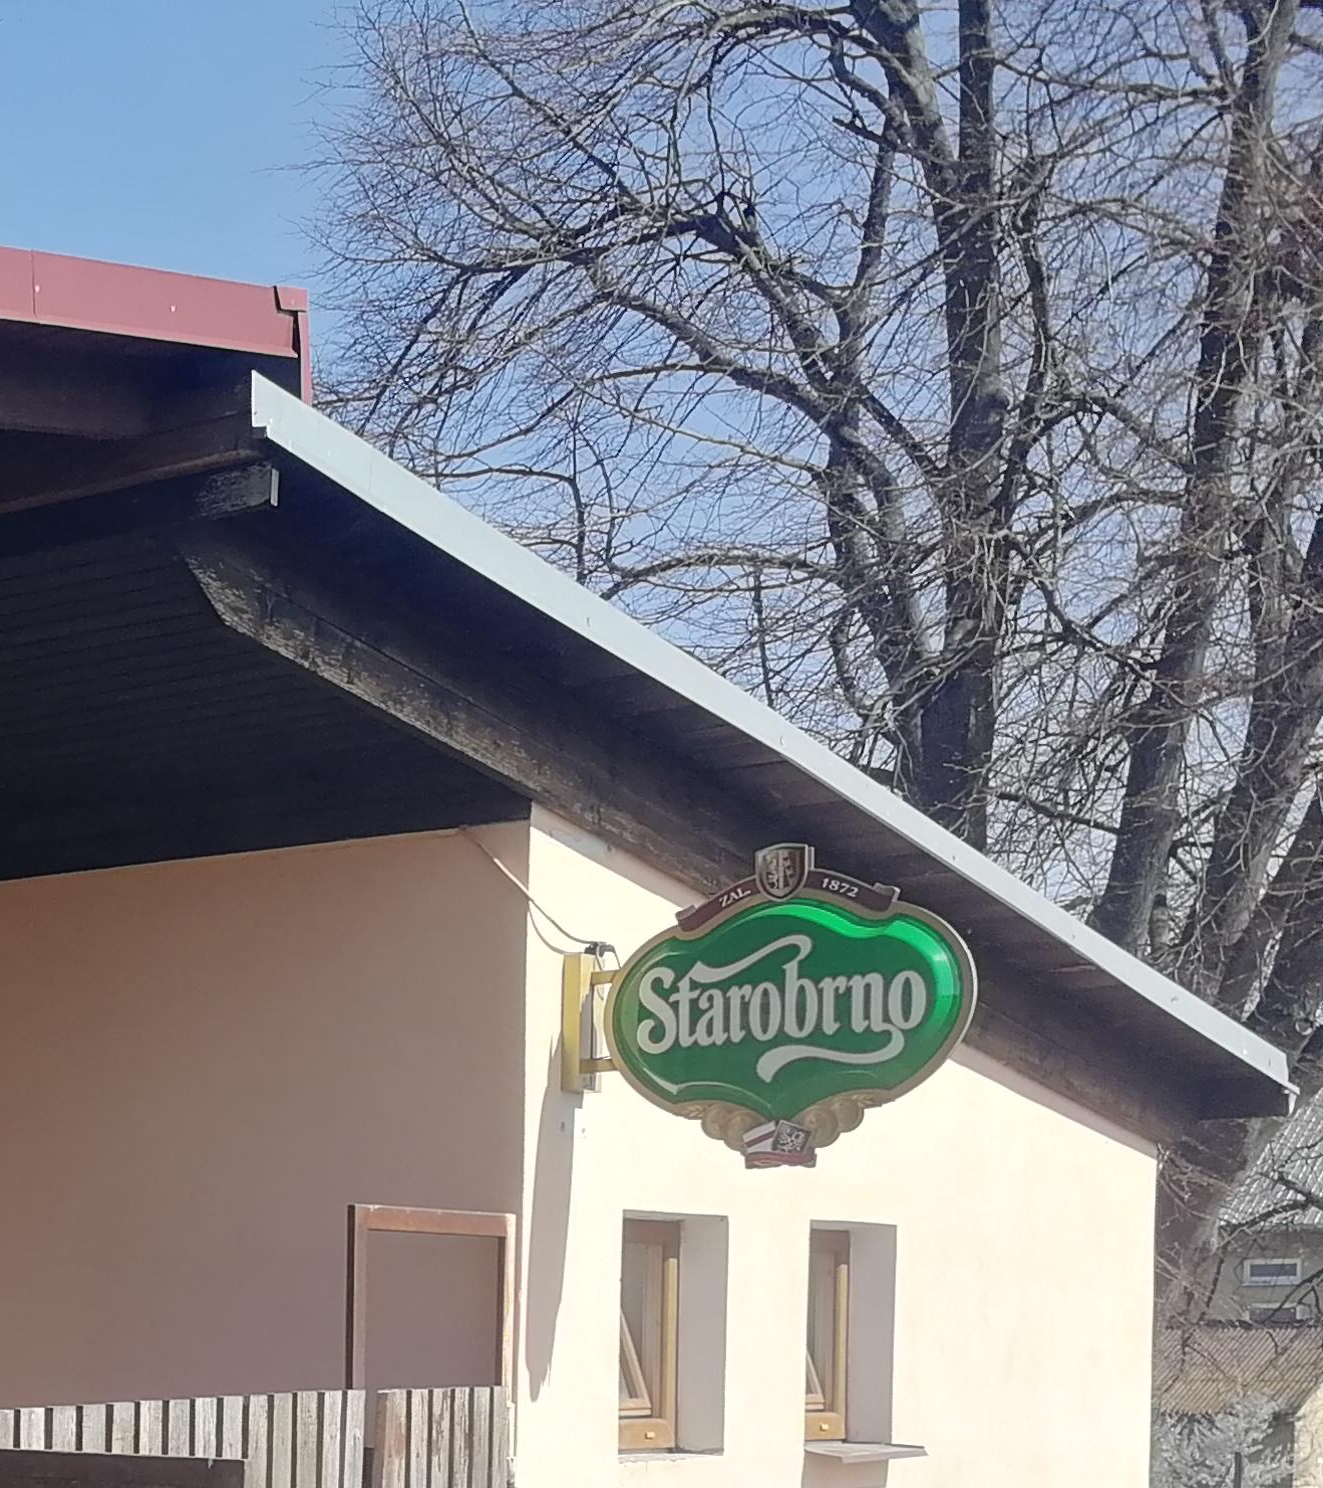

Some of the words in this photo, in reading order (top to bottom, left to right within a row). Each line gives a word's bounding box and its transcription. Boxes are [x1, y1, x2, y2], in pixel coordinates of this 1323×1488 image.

[718, 886, 752, 908] ZAL.
[820, 876, 860, 898] 1872
[636, 934, 927, 1084] Starobrno
